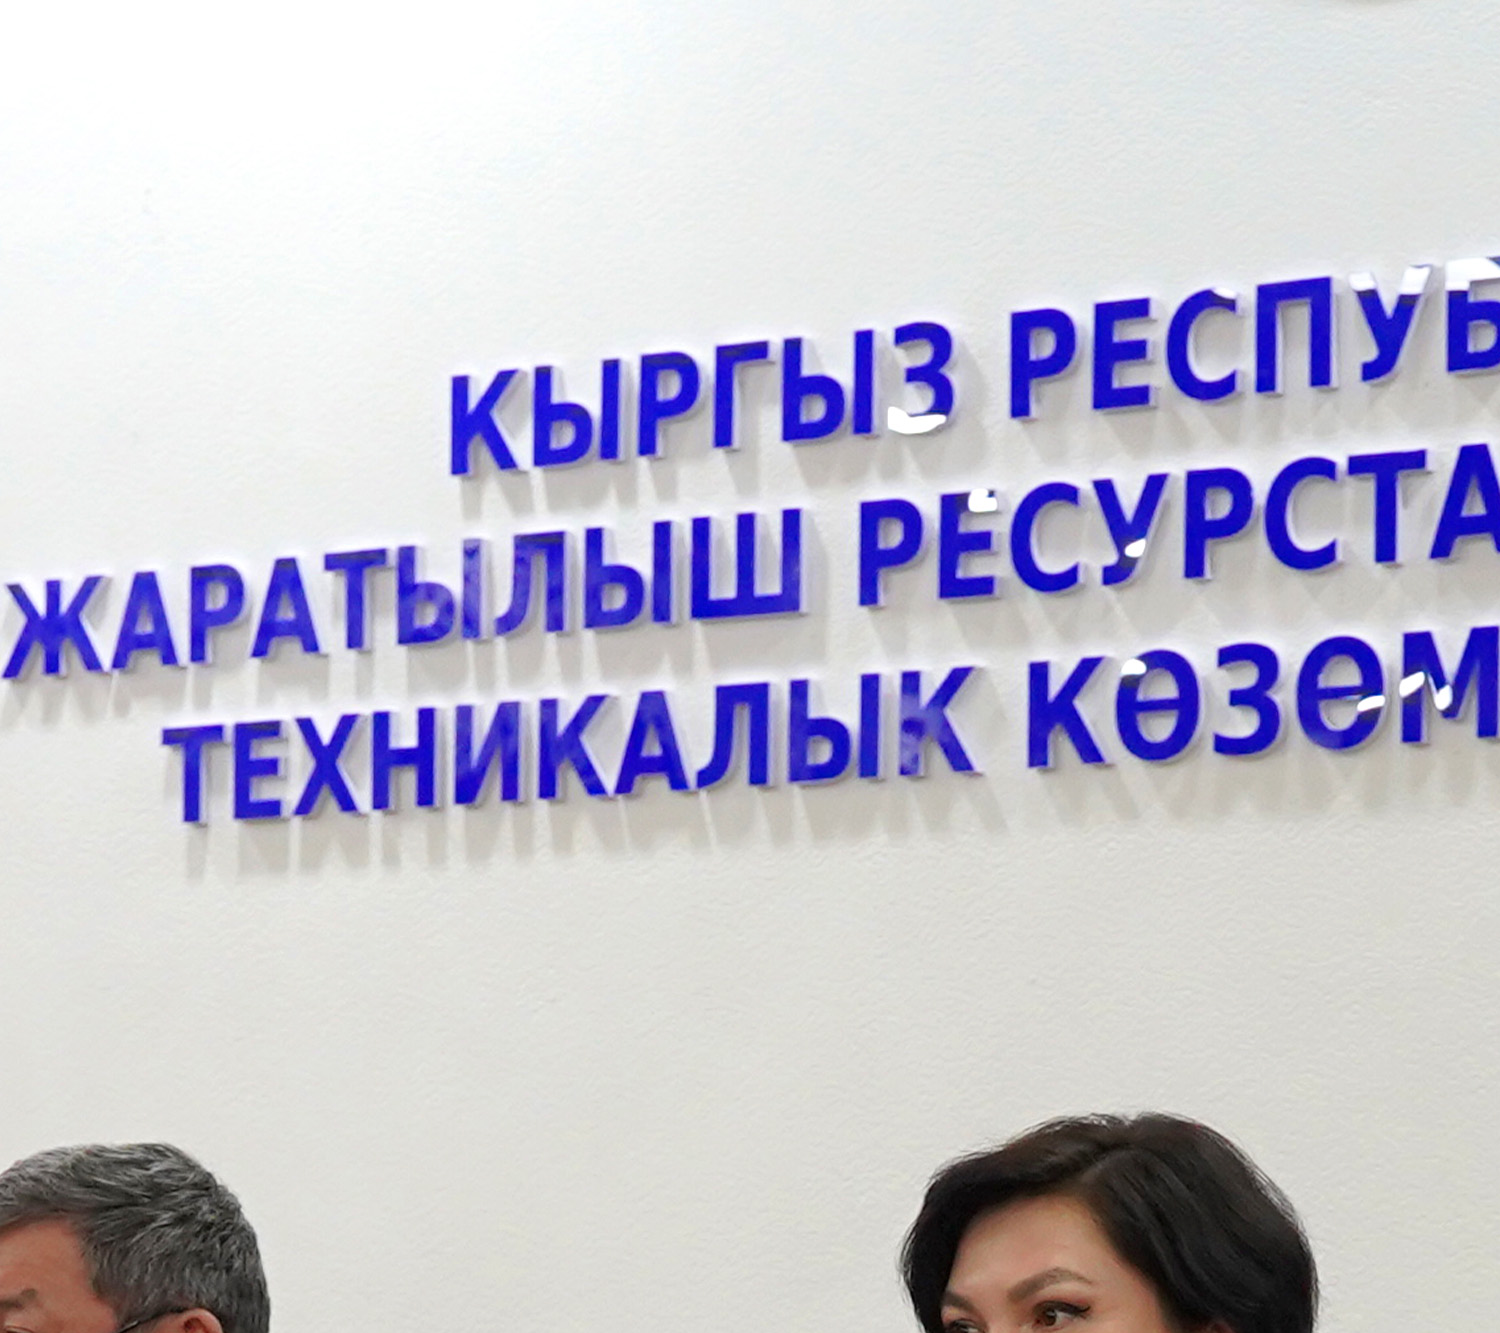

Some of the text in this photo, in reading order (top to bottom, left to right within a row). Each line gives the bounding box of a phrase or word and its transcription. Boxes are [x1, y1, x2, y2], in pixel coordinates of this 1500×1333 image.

[450, 322, 956, 475] КЫРГЫЗ
[1, 508, 803, 680] ЖАРАТЫЛЫШ
[161, 666, 976, 823] ТЕХНИКАЛЫК
